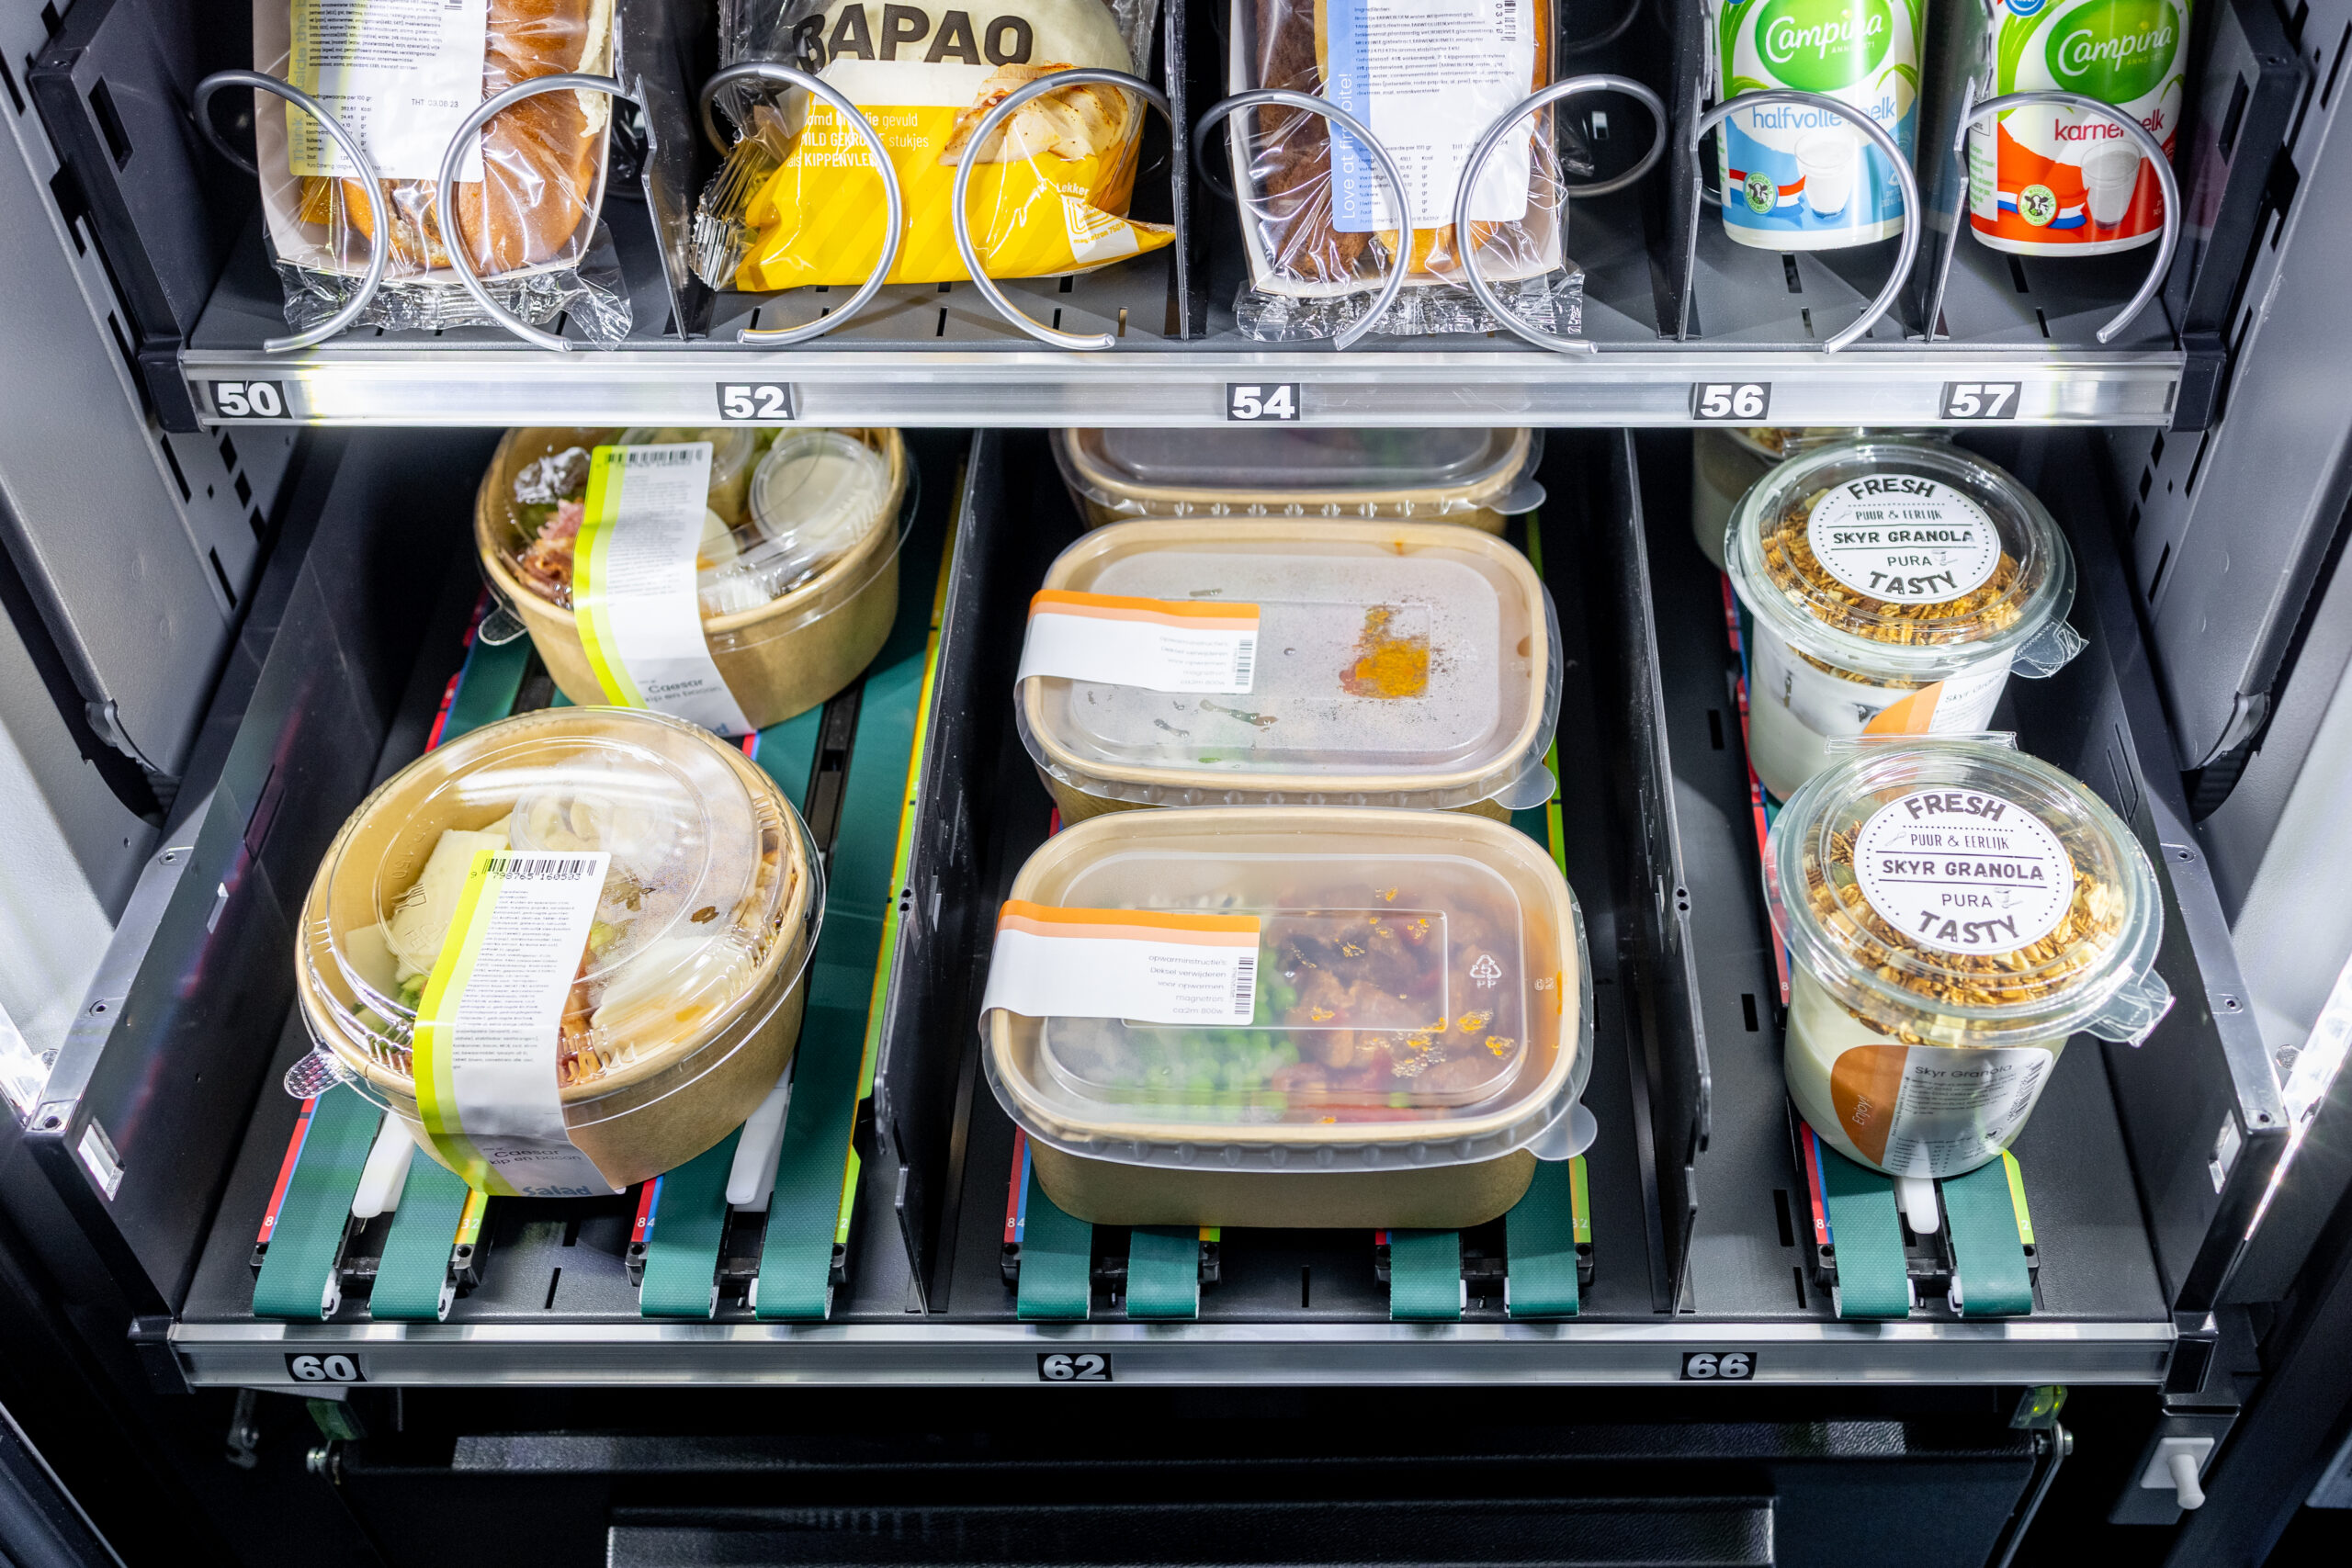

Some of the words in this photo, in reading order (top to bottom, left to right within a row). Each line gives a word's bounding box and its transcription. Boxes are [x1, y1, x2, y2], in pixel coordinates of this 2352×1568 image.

[792, 3, 1034, 75] BAPAO
[1765, 14, 1883, 63] Campina
[2058, 26, 2172, 76] Campina
[882, 113, 918, 129] gevuld
[1753, 106, 1841, 130] halfvolle
[2054, 108, 2165, 141] karneelk
[888, 135, 929, 151] stukjes
[1340, 154, 1354, 174] at
[1057, 182, 1090, 197] Lekker
[1342, 178, 1356, 219] Love
[217, 382, 282, 417] 50
[722, 386, 788, 419] 52
[1231, 385, 1295, 418] 54
[1700, 385, 1765, 418] 56
[1950, 385, 2016, 418] 57
[1847, 478, 1938, 501] FRESH
[1855, 509, 1883, 521] PUUR
[1888, 509, 1899, 520] &
[1903, 509, 1943, 521] EERLIJK
[1833, 531, 1881, 544] SKYR
[1887, 530, 1975, 543] GRANOLA
[1887, 555, 1933, 567] PURA
[1869, 570, 1958, 595] TASTY
[648, 679, 703, 694] Caesar
[1904, 793, 2007, 822] FRESH
[1910, 833, 1943, 847] PUUR
[1947, 834, 1960, 848] &
[1965, 835, 2010, 851] EERLIJK
[492, 872, 534, 881] 798765
[539, 873, 582, 881] 160503
[1883, 859, 1935, 874] SKYR
[1945, 862, 2044, 881] GRANOLA
[1941, 893, 1993, 908] PURA
[1918, 910, 2019, 944] TASTY
[1150, 966, 1177, 975] Deksel
[1179, 969, 1227, 978] verwijderen
[1175, 994, 1224, 1003] magnetron
[1914, 1066, 1947, 1078] Skyr
[1951, 1065, 2012, 1078] Granola
[1851, 1094, 1871, 1126] Enjoy!
[489, 1157, 511, 1166] kip
[494, 1148, 560, 1158] Caesar
[522, 1185, 594, 1196] Salad
[265, 1215, 275, 1227] 8
[840, 1218, 849, 1229] 2
[1815, 1218, 1825, 1230] 8
[2020, 1220, 2030, 1231] 2
[291, 1354, 358, 1382] 60
[1043, 1354, 1106, 1381] 62
[1687, 1352, 1750, 1379] 66
